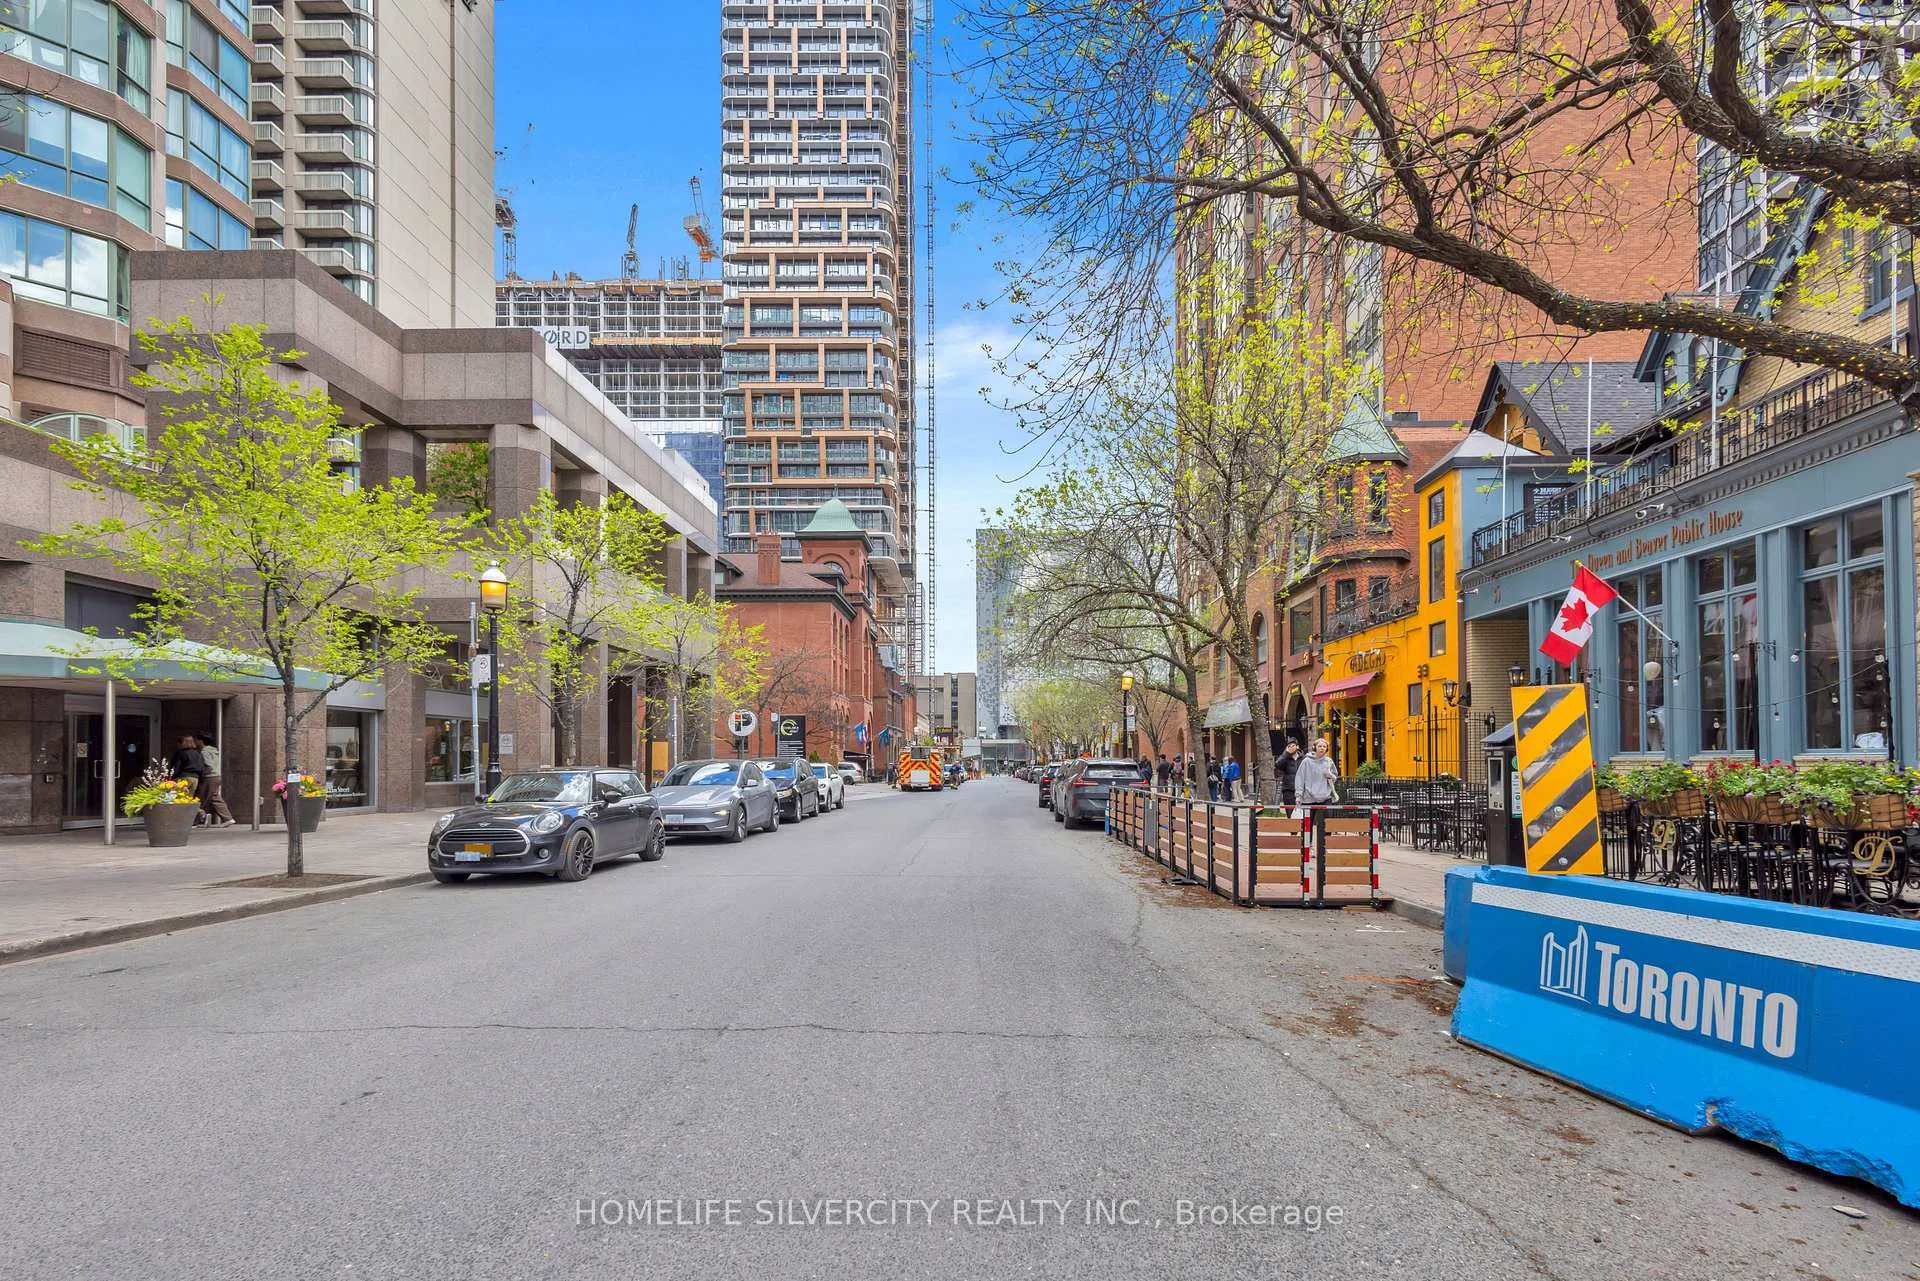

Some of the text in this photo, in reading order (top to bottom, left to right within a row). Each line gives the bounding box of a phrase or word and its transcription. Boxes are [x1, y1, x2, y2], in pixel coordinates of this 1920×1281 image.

[1588, 552, 1614, 573] Queen
[1616, 541, 1633, 565] and
[1636, 535, 1668, 559] Beaver
[1671, 519, 1704, 548] Public
[1709, 510, 1743, 537] House
[1595, 941, 1799, 1058] TORONTO
